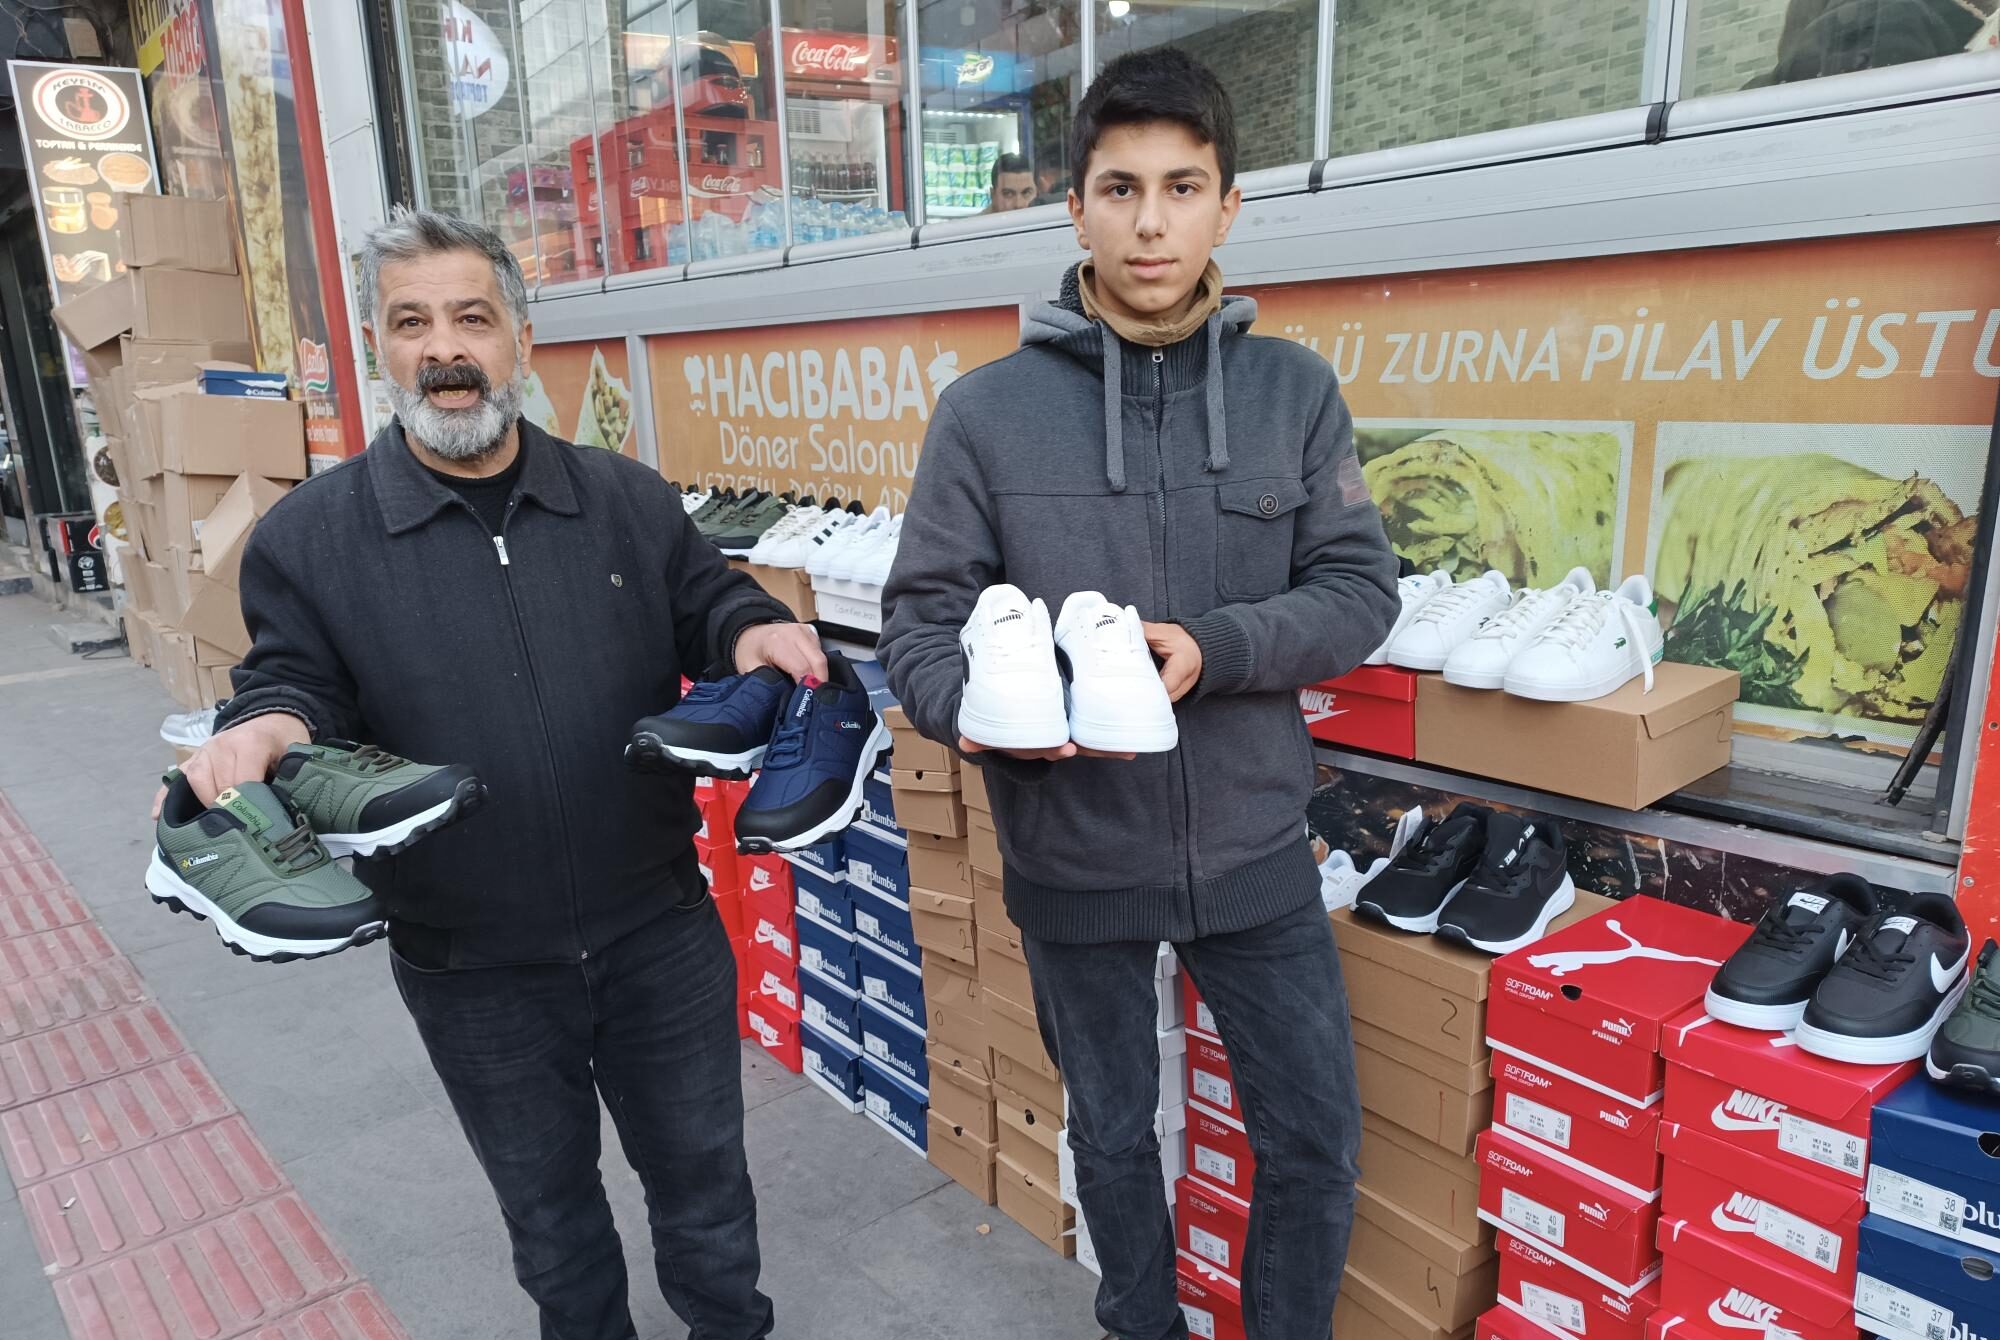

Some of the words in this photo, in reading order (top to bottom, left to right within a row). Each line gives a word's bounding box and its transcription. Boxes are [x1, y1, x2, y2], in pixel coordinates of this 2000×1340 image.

[791, 40, 858, 71] Coca-Cola
[702, 174, 742, 192] Coca-Cola
[1379, 326, 1560, 383] ZURNA
[1581, 306, 1781, 382] PİLAV
[707, 345, 928, 421] HACIBABA
[720, 421, 799, 470] Döner
[808, 424, 918, 478] Salonu
[795, 688, 813, 718] Columbia
[1300, 688, 1337, 713] NIKE
[232, 801, 262, 828] Columbia
[869, 809, 898, 831] olumbia
[188, 852, 219, 867] Columbia
[870, 869, 897, 892] olumbia
[820, 958, 846, 981] olumbia
[886, 994, 914, 1018] olumbia
[825, 1010, 850, 1034] olumbia
[887, 1053, 916, 1077] olumbia
[1725, 1089, 1789, 1124] NIKE
[888, 1111, 916, 1139] olumbia
[1846, 1140, 1857, 1153] 40
[1725, 1191, 1760, 1222] NI
[1944, 1197, 1956, 1212] 38
[1963, 1201, 2000, 1230] olu
[1818, 1233, 1829, 1248] 39
[1721, 1287, 1783, 1328] NIKE
[1930, 1309, 1943, 1322] 37
